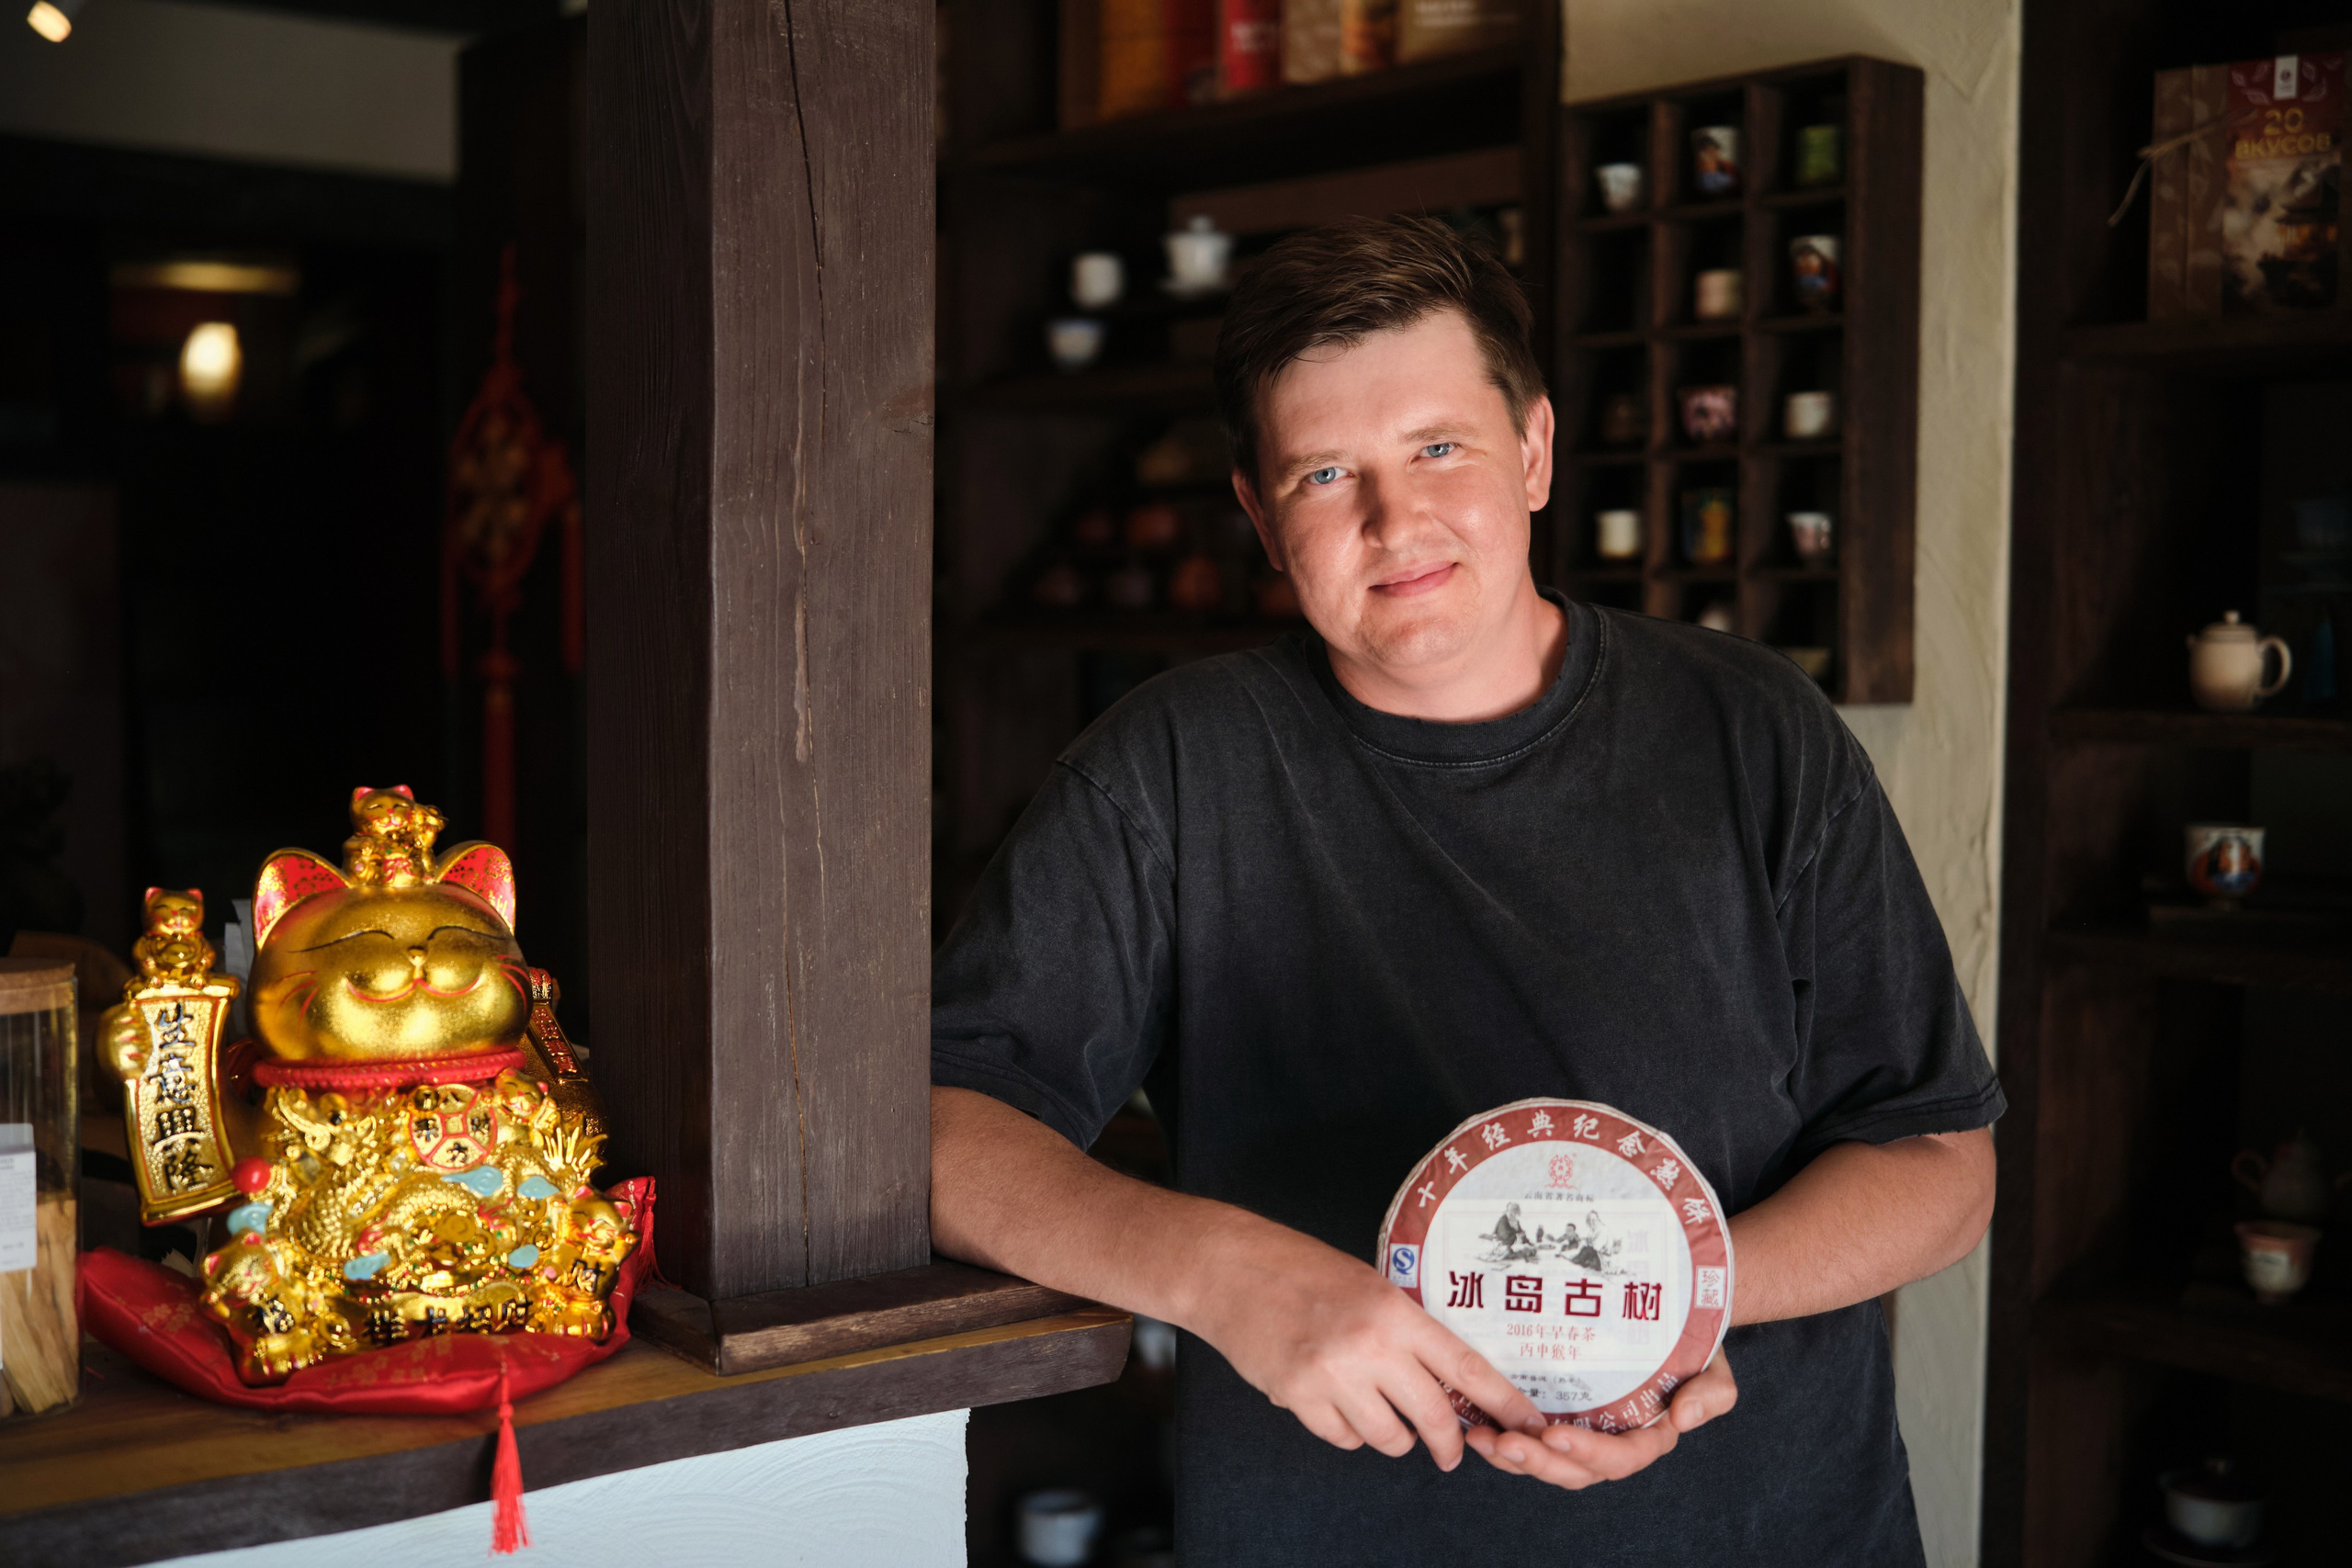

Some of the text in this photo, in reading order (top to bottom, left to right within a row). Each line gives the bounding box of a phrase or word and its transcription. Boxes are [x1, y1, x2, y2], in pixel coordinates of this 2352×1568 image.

[2264, 107, 2304, 136] 20
[2234, 132, 2331, 160] ВКУСОВ
[1447, 1270, 1662, 1321] 冰岛古树
[1702, 1269, 1720, 1306] 珍藏
[1507, 1324, 1596, 1343] 2016年早春茶
[1520, 1343, 1581, 1360] 丙申猴年
